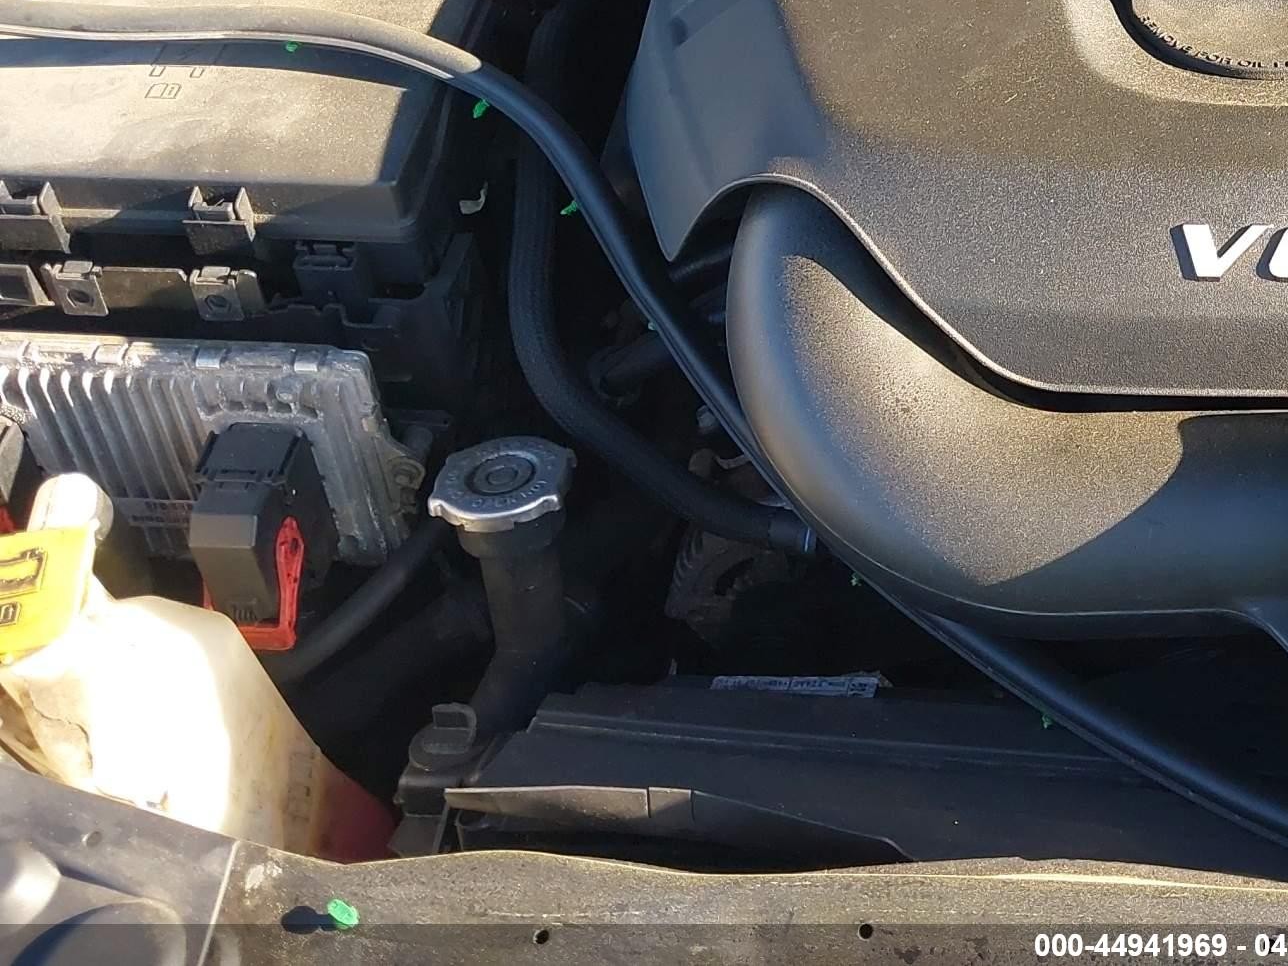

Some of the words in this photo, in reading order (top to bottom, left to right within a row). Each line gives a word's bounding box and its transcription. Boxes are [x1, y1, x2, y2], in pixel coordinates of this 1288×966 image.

[1140, 15, 1193, 55] REMOVE
[1193, 49, 1233, 66] FOR
[1237, 59, 1266, 69] OIL
